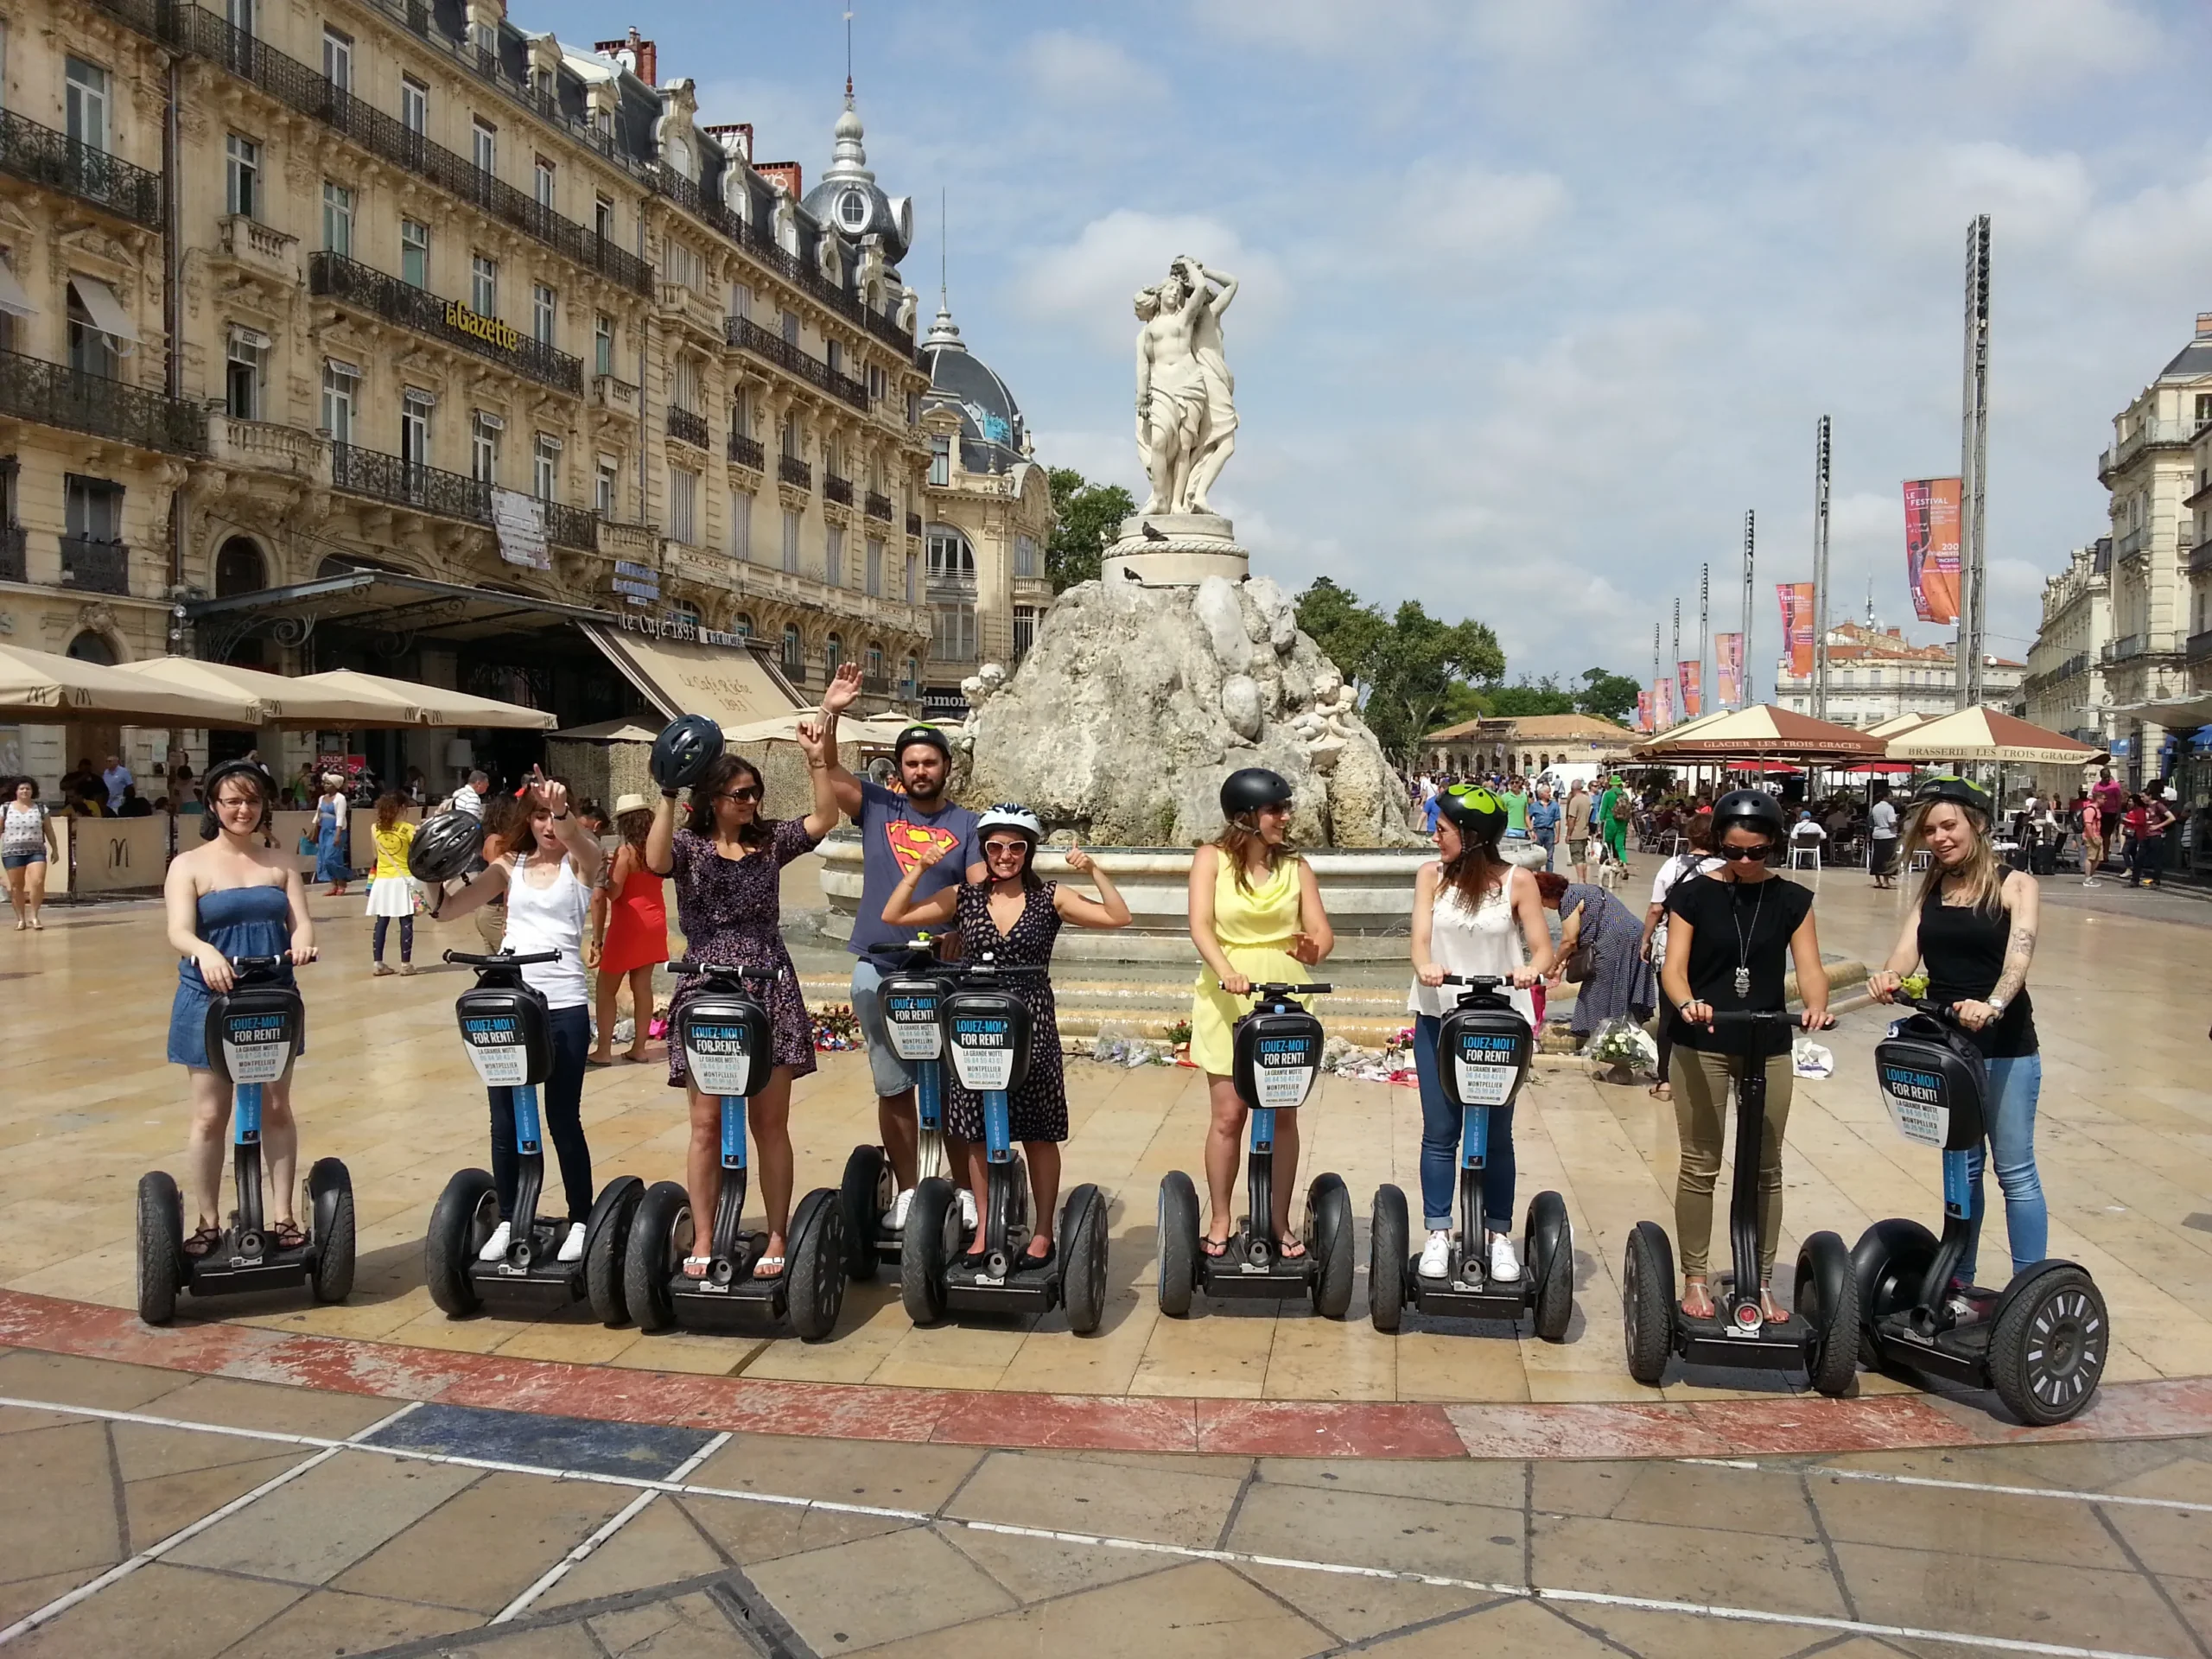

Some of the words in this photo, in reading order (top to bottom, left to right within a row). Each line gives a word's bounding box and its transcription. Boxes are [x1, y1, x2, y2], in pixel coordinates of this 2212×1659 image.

[1910, 498, 1948, 506] FESTIVAL
[672, 621, 695, 641] 1893
[719, 698, 747, 712] 1893
[1908, 747, 1967, 756] BRASSERIE
[1976, 748, 1997, 757] LES
[2002, 749, 2036, 759] TROIS
[2041, 752, 2086, 761] GRACES
[891, 998, 932, 1009] LOUEZ-MOI
[895, 1010, 910, 1021] FOR
[912, 1010, 934, 1021] RENT!
[466, 1019, 512, 1032] LOUEZ-MOI
[957, 1020, 1001, 1033] LOUEZ-MOI
[472, 1032, 490, 1044] FOR
[491, 1031, 515, 1043] RENT!
[961, 1033, 977, 1046] FOR
[979, 1033, 1003, 1046] RENT!
[1463, 1036, 1510, 1050] LOUEZ-MOI
[696, 1039, 713, 1052] FOR
[1261, 1039, 1304, 1052] LOUEZ-MOI
[1264, 1053, 1280, 1065] FOR
[1281, 1052, 1305, 1065] RENT!
[1465, 1049, 1484, 1062] FOR
[1484, 1050, 1510, 1063] RENT!
[1886, 1068, 1935, 1088] LOUEZ-MOI
[1892, 1082, 1910, 1097] FOR
[1910, 1086, 1938, 1103] RENT!
[1903, 1101, 1922, 1110] GRANDE
[1922, 1104, 1938, 1114] MOTTE
[1902, 1116, 1937, 1129] MONTPELLIER
